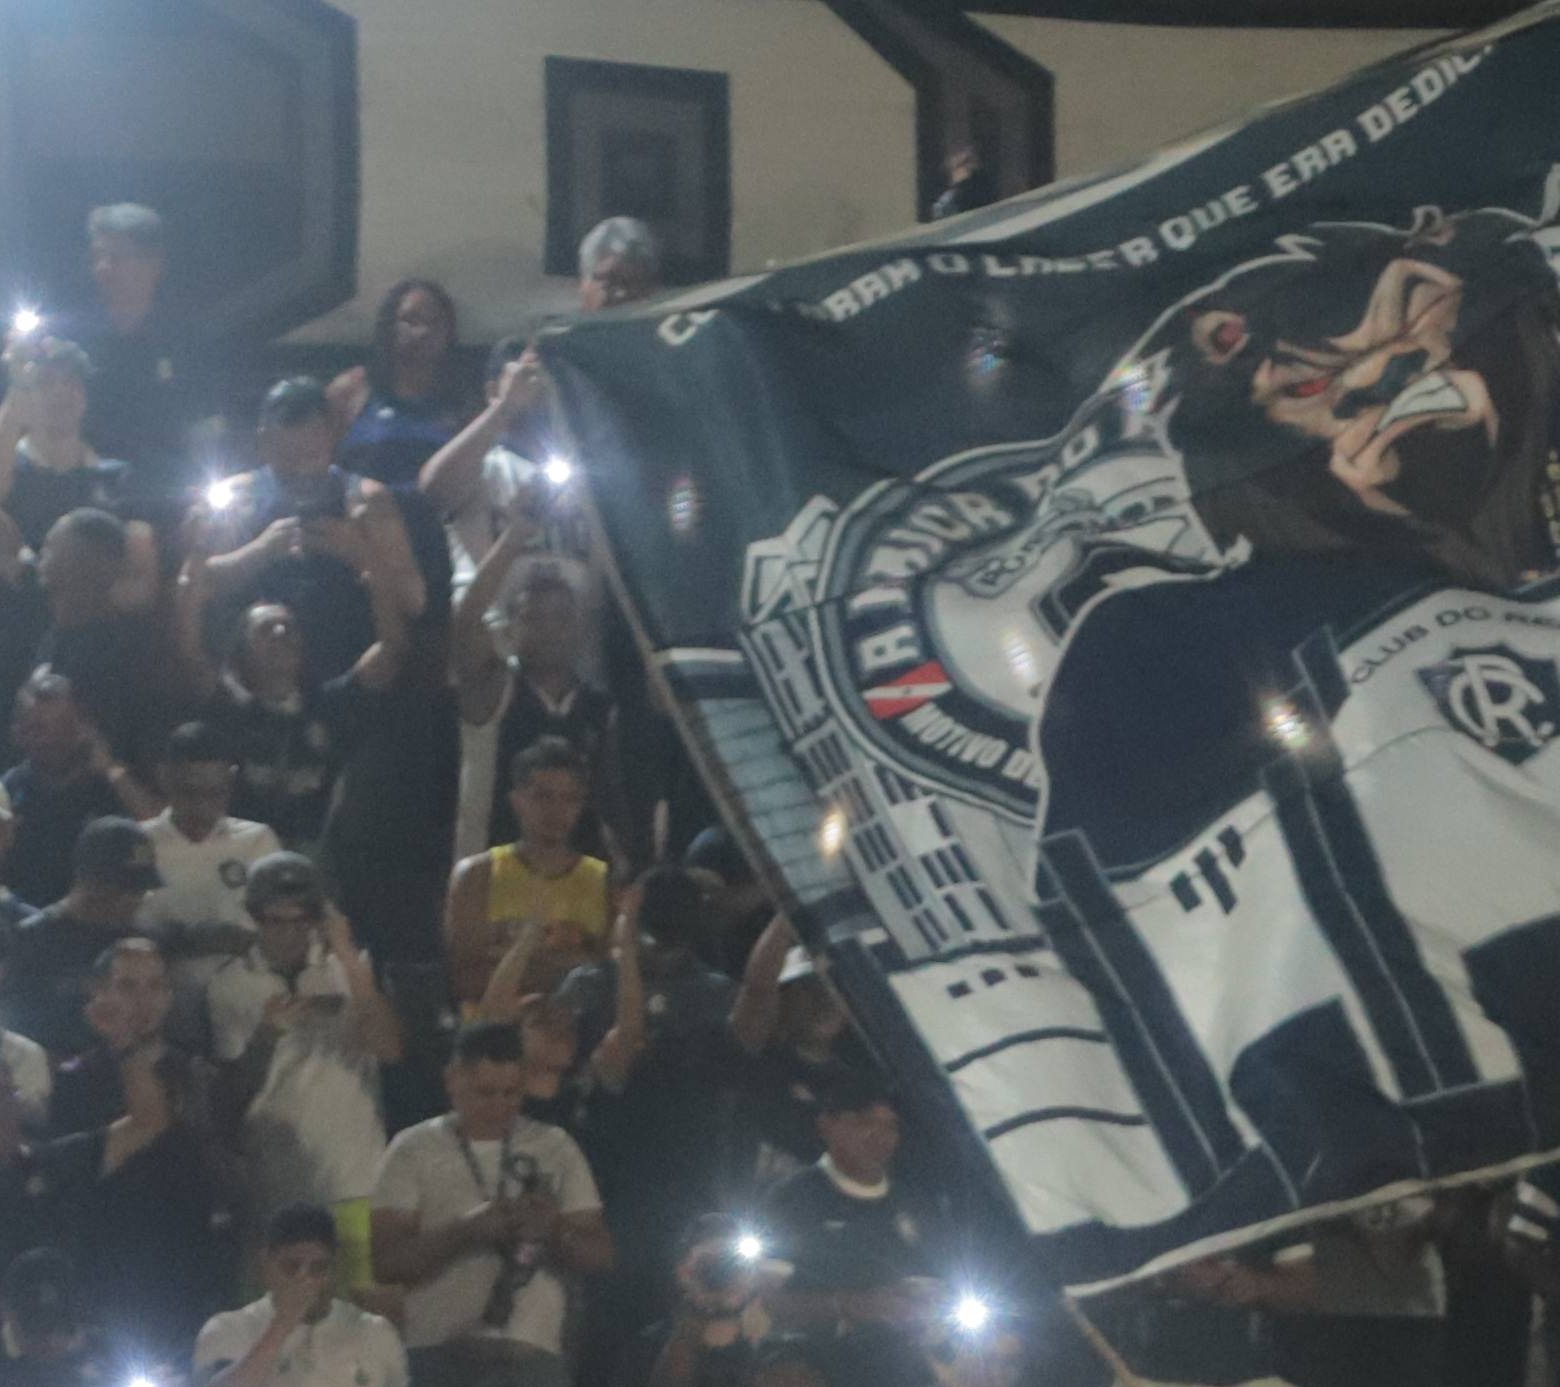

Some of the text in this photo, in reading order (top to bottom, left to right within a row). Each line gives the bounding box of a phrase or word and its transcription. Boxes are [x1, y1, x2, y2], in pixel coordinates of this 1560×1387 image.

[1157, 184, 1260, 252] QUE
[1260, 128, 1357, 200] ERA
[1350, 623, 1430, 685] CLUB
[1434, 605, 1492, 627] DO
